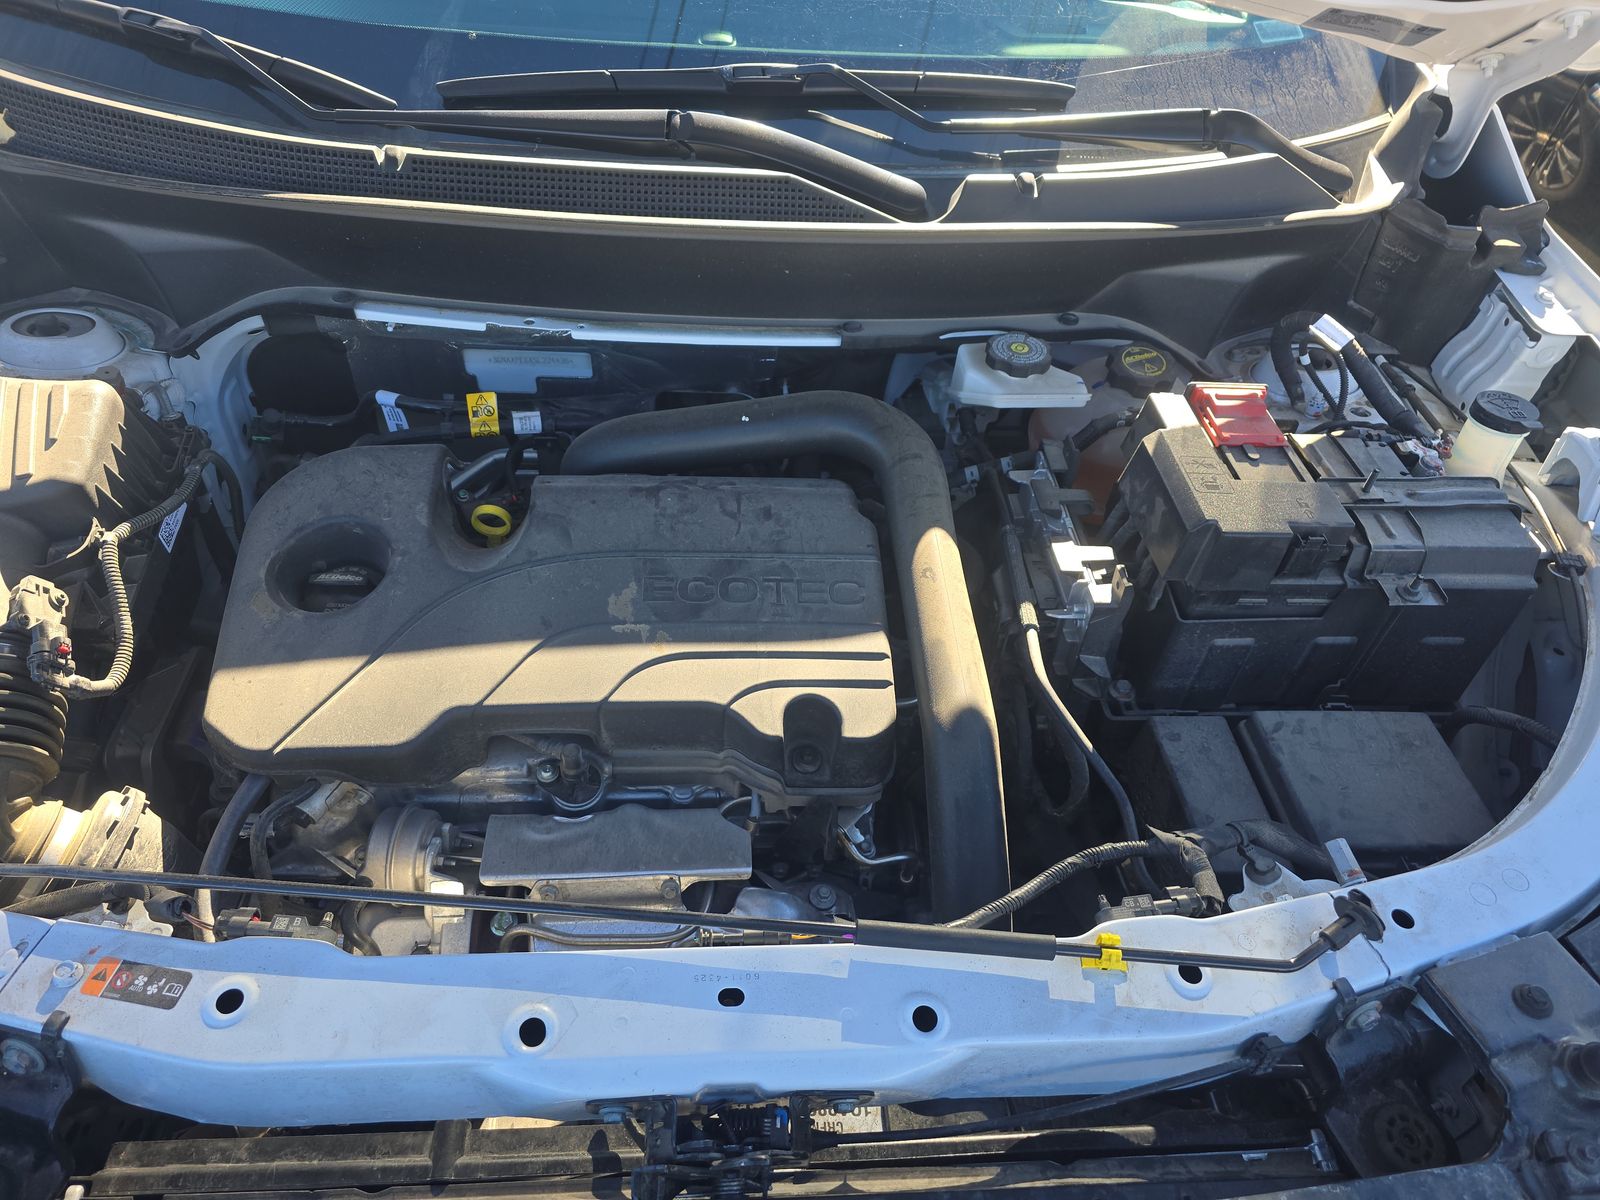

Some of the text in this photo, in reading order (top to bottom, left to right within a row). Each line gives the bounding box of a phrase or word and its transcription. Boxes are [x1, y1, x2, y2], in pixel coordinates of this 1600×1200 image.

[642, 576, 865, 606] ECOTEC
[293, 917, 302, 926] B
[128, 984, 144, 992] AUTO
